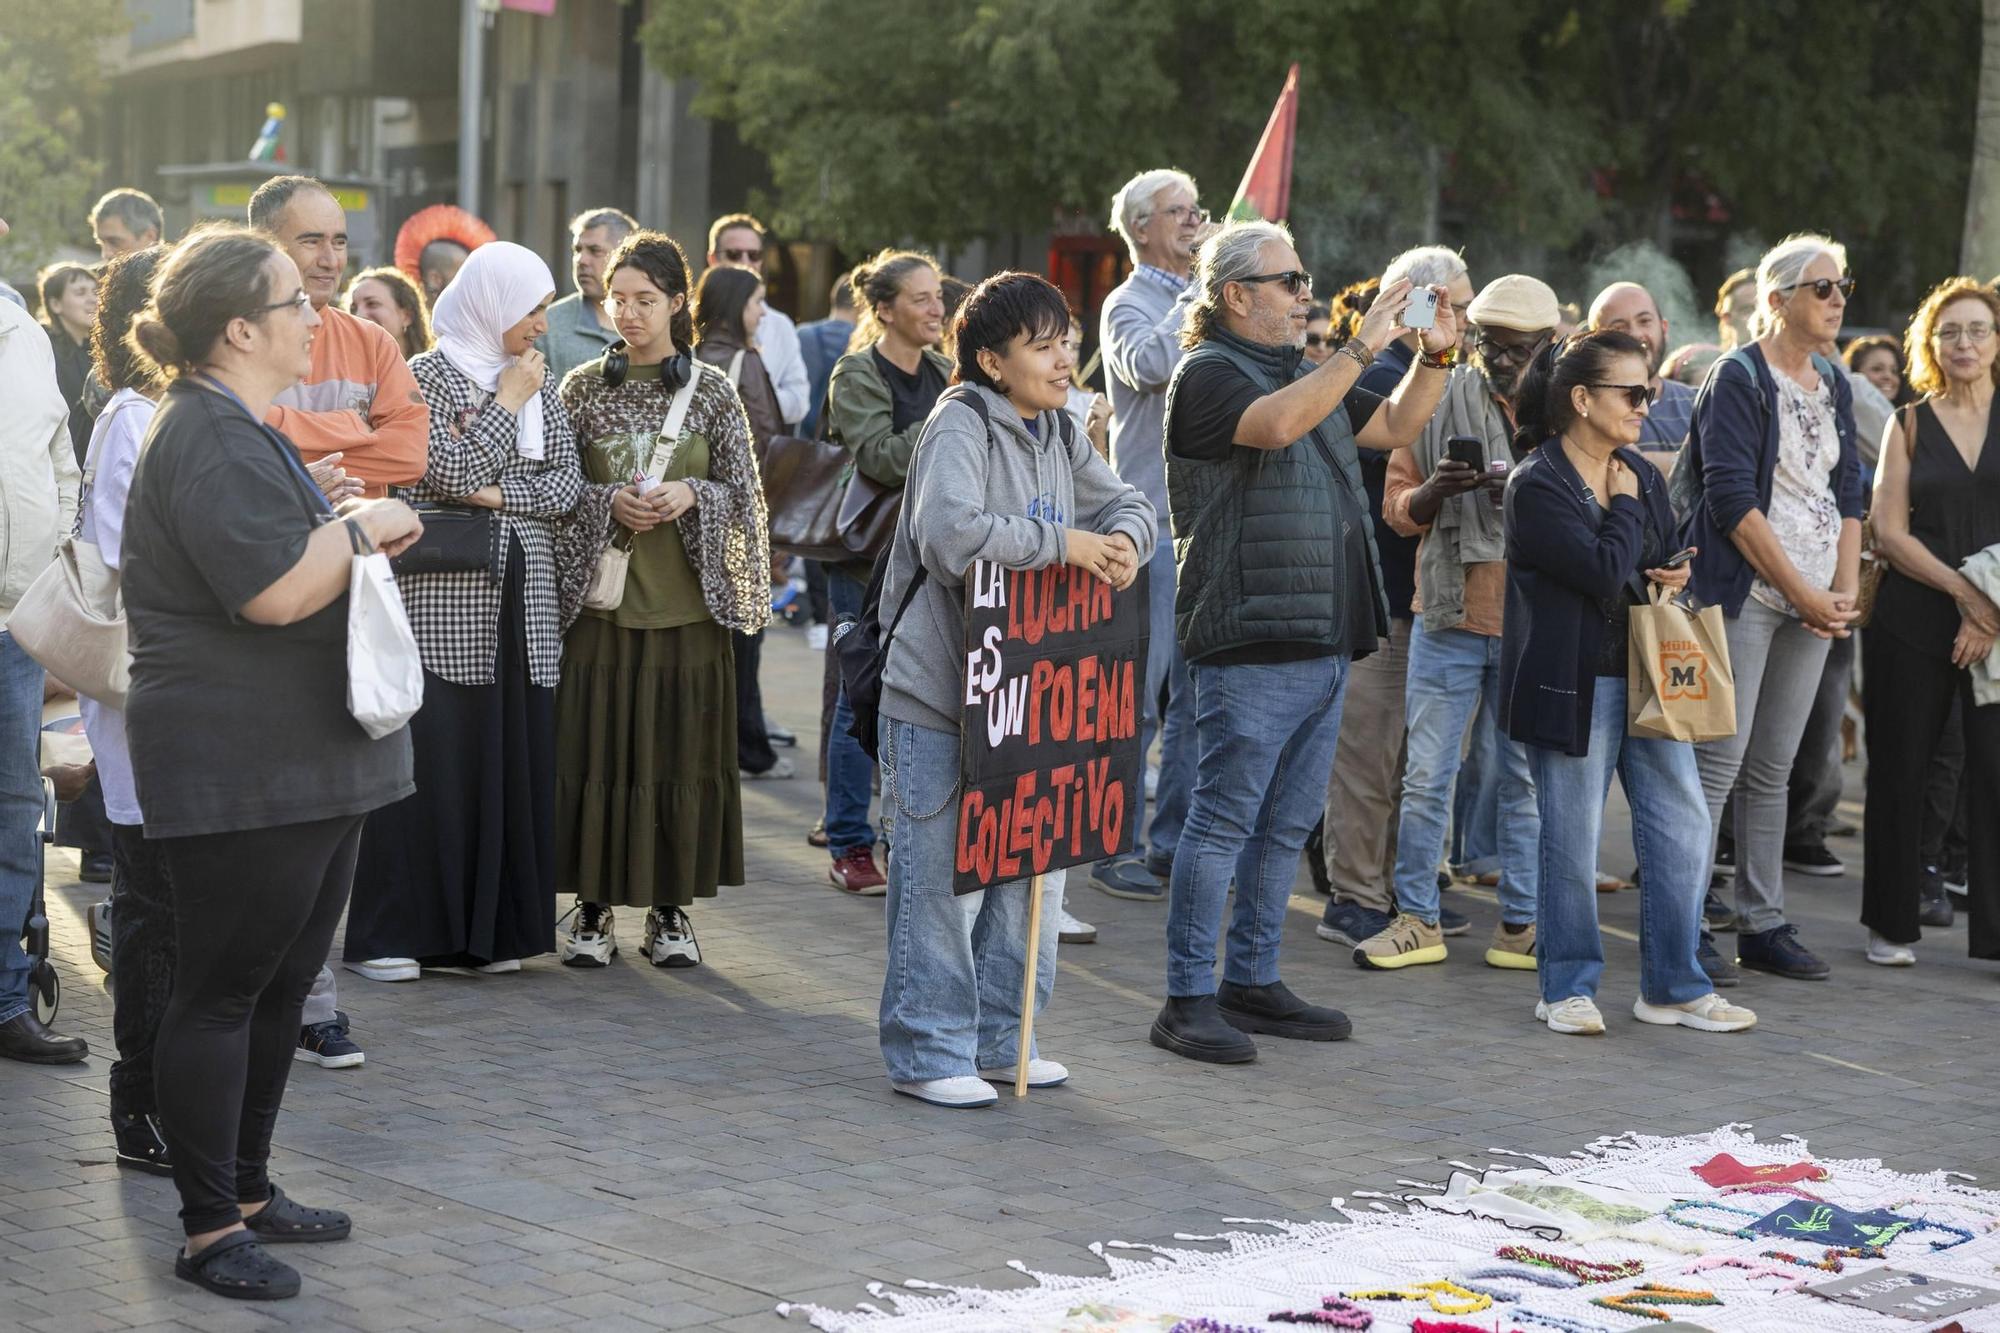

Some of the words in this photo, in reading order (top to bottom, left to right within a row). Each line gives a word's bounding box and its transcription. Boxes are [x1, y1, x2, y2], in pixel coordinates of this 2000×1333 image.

[973, 559, 1006, 609] LA
[1007, 561, 1112, 645] LUCHA
[966, 626, 1002, 705] ES
[988, 675, 1028, 747] UN
[1029, 655, 1135, 746] POEMA
[1671, 666, 1696, 687] M
